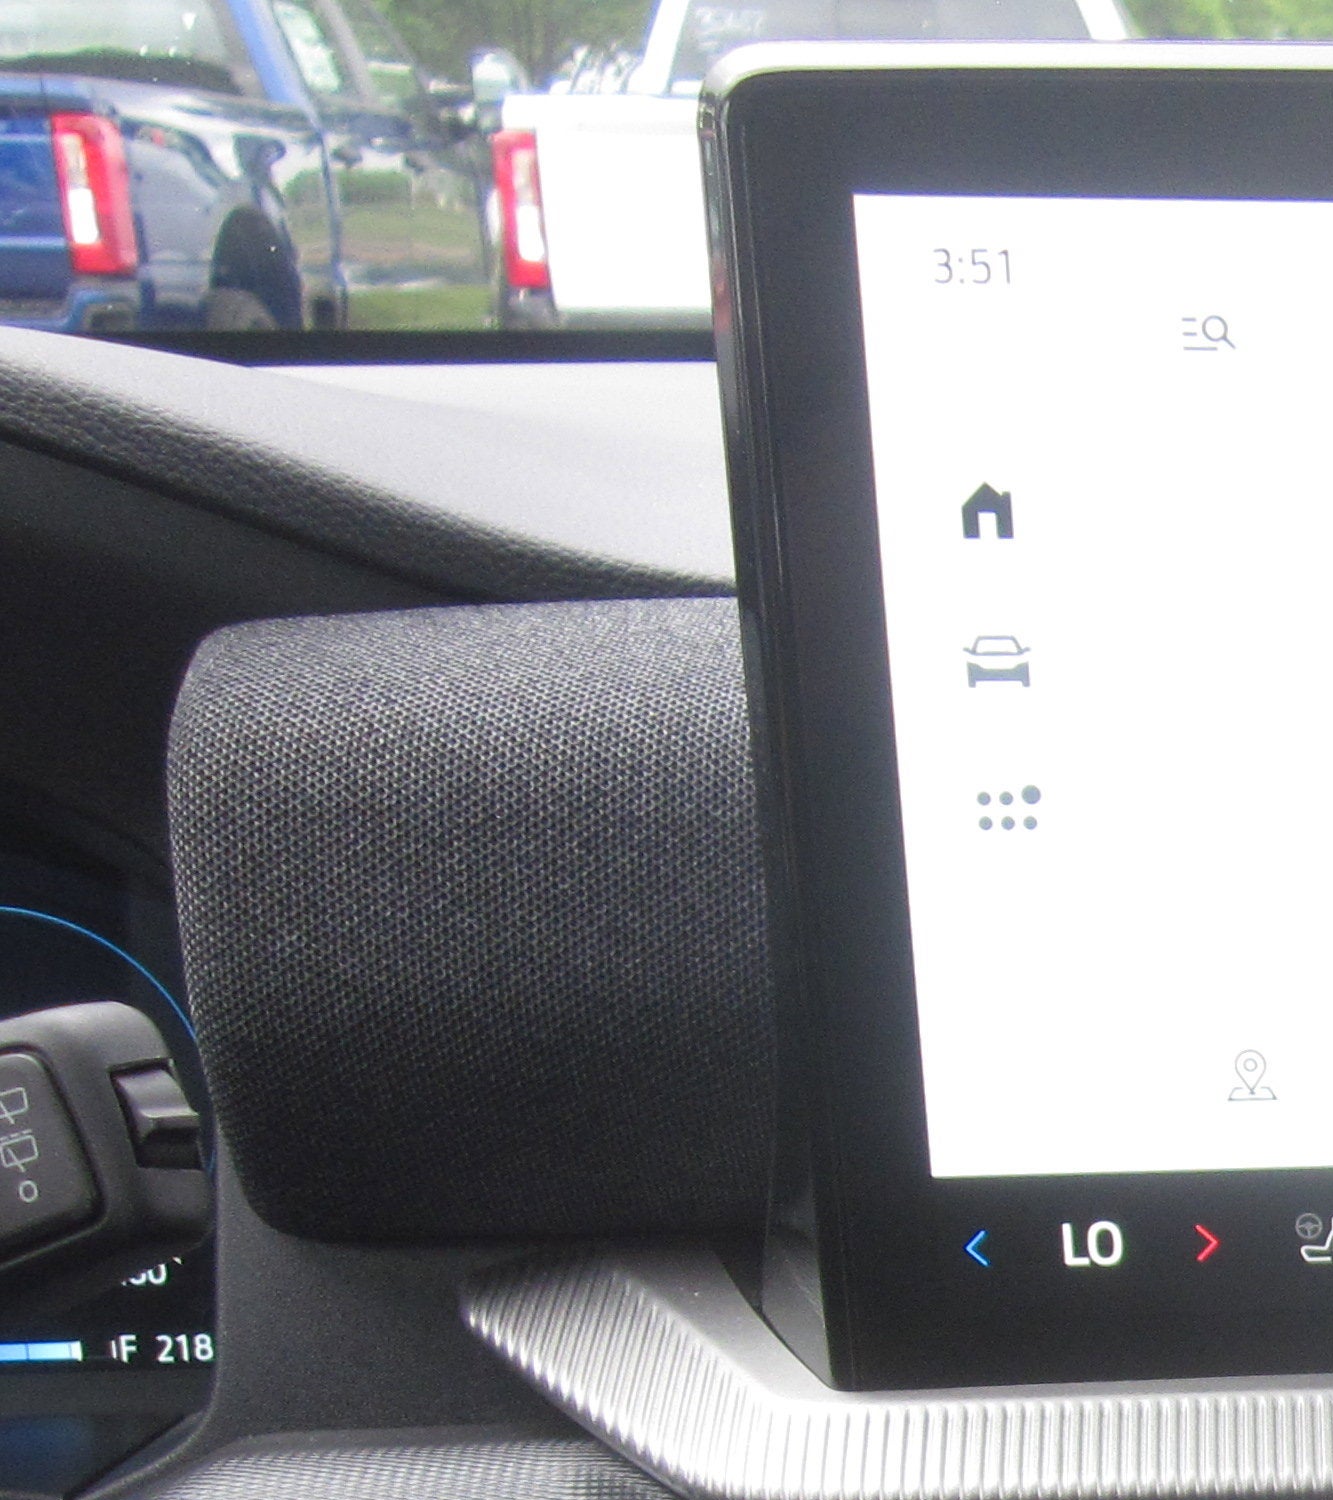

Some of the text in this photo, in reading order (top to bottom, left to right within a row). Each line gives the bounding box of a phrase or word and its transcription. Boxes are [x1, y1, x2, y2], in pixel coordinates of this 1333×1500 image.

[932, 247, 1011, 286] 3:51
[1061, 1220, 1125, 1269] LO
[156, 1333, 215, 1364] 218
